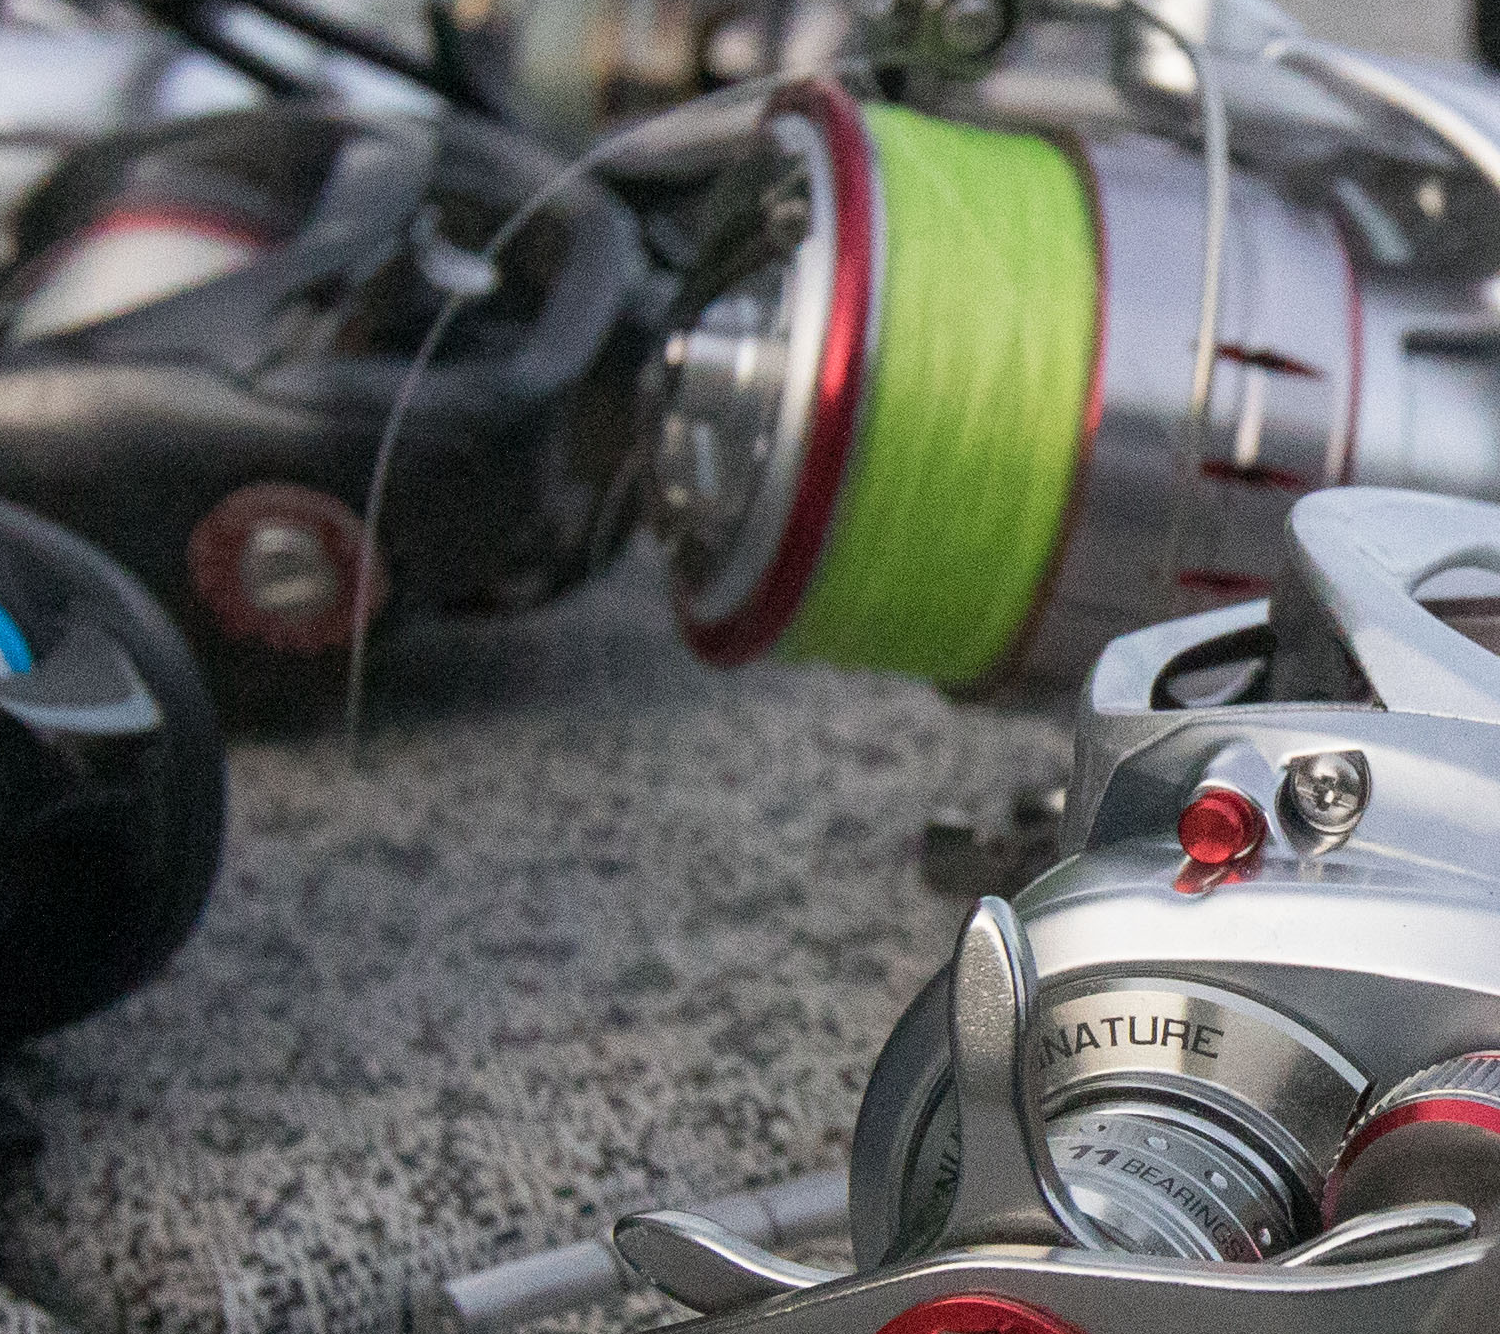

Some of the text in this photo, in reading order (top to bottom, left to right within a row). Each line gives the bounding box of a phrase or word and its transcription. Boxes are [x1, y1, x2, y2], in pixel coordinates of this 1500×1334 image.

[1041, 1015, 1225, 1061] NATURE
[1068, 1144, 1246, 1260] 11 BEARINGS
